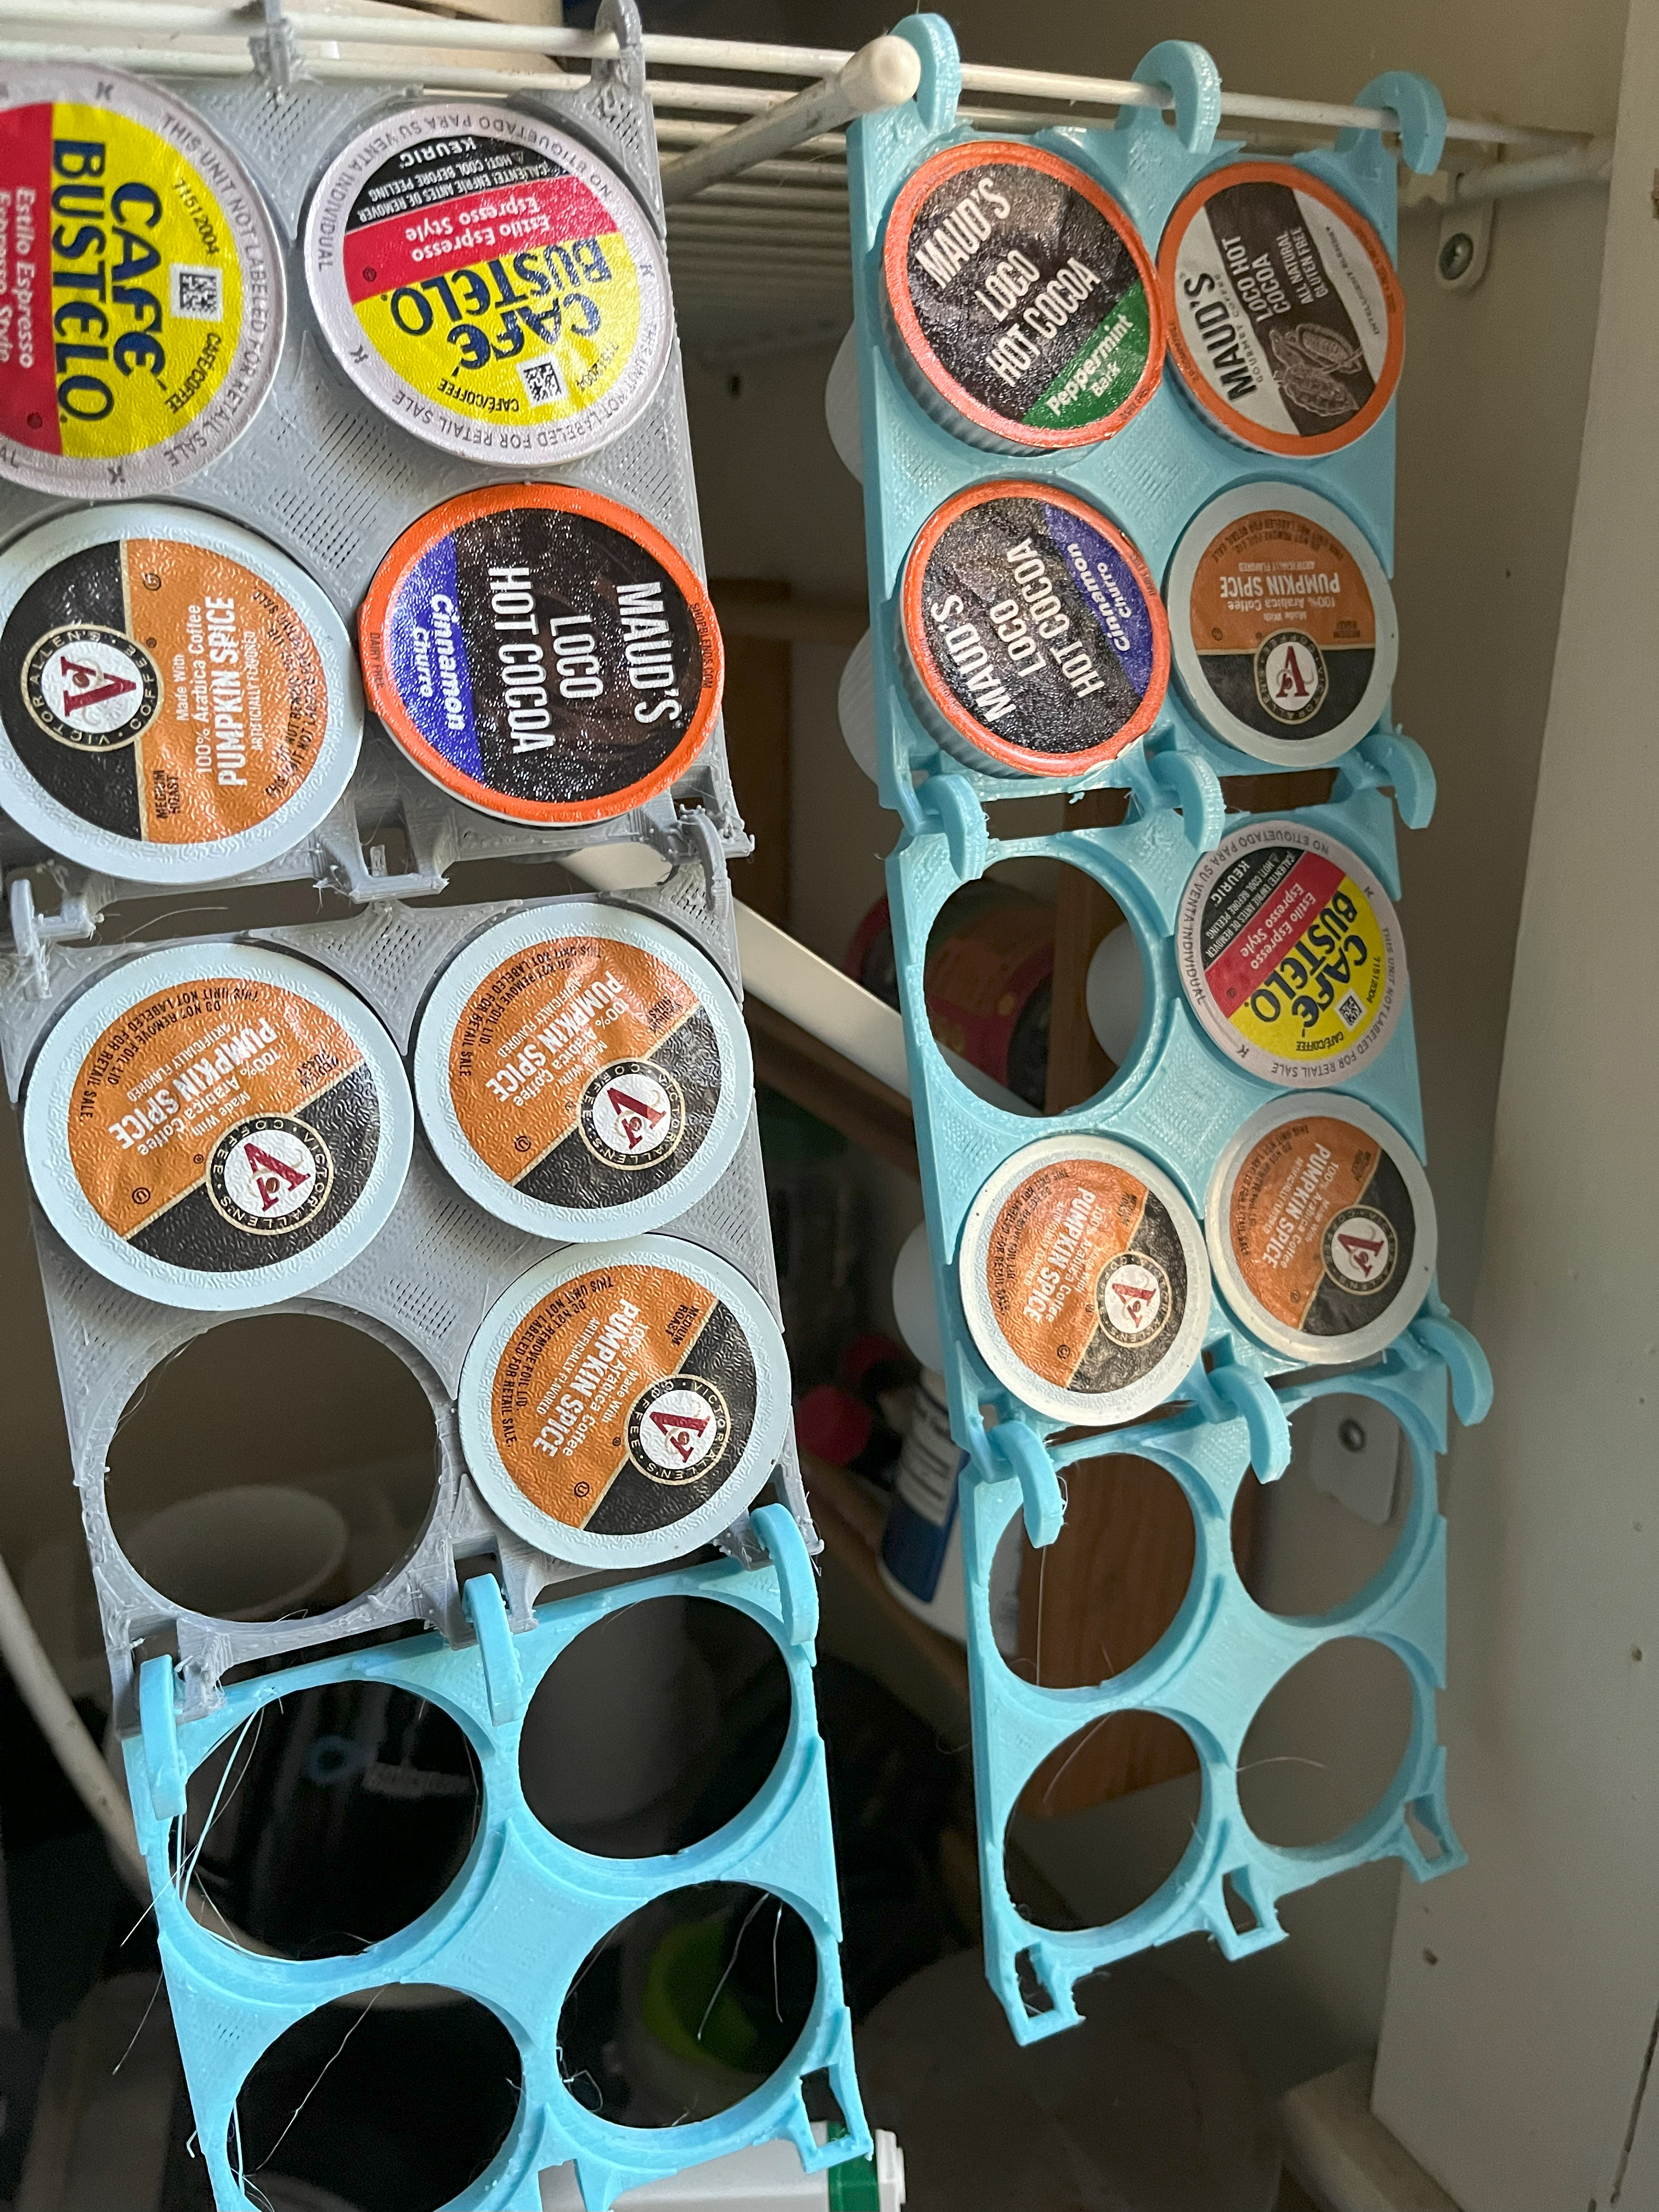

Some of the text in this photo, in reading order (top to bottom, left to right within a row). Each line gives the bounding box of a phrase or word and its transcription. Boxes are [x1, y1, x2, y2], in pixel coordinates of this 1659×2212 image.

[162, 115, 197, 153] THIS
[195, 155, 235, 193] UNIT
[366, 177, 413, 202] PEELING
[414, 165, 456, 189] BEFORE
[229, 198, 256, 238] NOT
[402, 212, 453, 245] Style
[408, 212, 550, 266] Estilo Espresso
[914, 171, 1014, 291] MAUD'S
[10, 187, 36, 368] Estilo Espresso
[244, 242, 268, 334] LABELED
[974, 245, 1041, 324] LOCO
[1219, 233, 1273, 323] LOCO HOT
[1250, 253, 1292, 315] COCOA
[1272, 231, 1315, 305] ALL NATURAL
[1288, 225, 1329, 298] GLUTEN FREE
[986, 255, 1098, 388] HOT COCOA
[1178, 272, 1261, 400] MAUD'S
[1045, 309, 1135, 419] Peppermint
[204, 379, 249, 439] RETAIL
[162, 432, 207, 468] SALE
[1063, 539, 1131, 655] Cinnamon
[1219, 572, 1340, 598] PUMPKIN SPICE
[1227, 599, 1261, 611] Coffee
[185, 604, 204, 654] Coffee
[986, 595, 1046, 679] LOCO
[1001, 537, 1105, 701] HOT COCOA
[427, 592, 475, 730] Cinnamon
[486, 565, 556, 752] HOT COCOA
[548, 614, 605, 699] LOCO
[615, 582, 682, 724] MAUD'S
[928, 590, 1017, 724] MAUD'S
[172, 654, 189, 721] Made With
[205, 595, 248, 787] PUMPKIN SPICE
[194, 727, 212, 773] 100%
[1245, 874, 1262, 893] COOL
[1257, 859, 1274, 878] HOT!
[1182, 831, 1331, 1006] NO ETIQUETADO PARA SU VENTA INDIVIDUAL
[1204, 911, 1231, 939] PEELING
[1205, 927, 1233, 958] REMOVER
[1237, 881, 1305, 959] Espresso Style
[1246, 891, 1317, 970] Estilo Espresso
[537, 968, 624, 1054] PUMPKIN
[1290, 935, 1370, 1038] CAFÉ
[1379, 989, 1393, 1009] NOT
[84, 997, 174, 1086] LABELED FOR RETAIL
[172, 1014, 275, 1104] PUMPKIN
[1337, 1051, 1357, 1068] FOR
[1354, 1012, 1386, 1054] LABELED
[126, 1063, 172, 1103] FLAVORED
[484, 1040, 547, 1103] SPICE
[511, 1067, 554, 1109] Coffee
[1272, 1064, 1301, 1076] SALE
[1303, 1062, 1336, 1075] RETAIL
[109, 1086, 178, 1150] SPICE
[181, 1074, 240, 1124] Arabica
[190, 1089, 250, 1138] Made With
[136, 1115, 185, 1158] Coffee
[210, 1118, 285, 1175] COFFEE
[1284, 1142, 1331, 1219] PUMPKIN
[1045, 1186, 1098, 1268] PUMPKIN
[1260, 1216, 1295, 1269] SPICE
[1279, 1233, 1302, 1270] Coffee
[544, 1298, 566, 1318] NOT
[589, 1276, 614, 1291] THIS
[1019, 1266, 1061, 1325] SPICE
[1044, 1283, 1072, 1325] Coffee
[513, 1313, 547, 1358] LABELED
[524, 1325, 556, 1365] REMOVE
[552, 1308, 573, 1330] NOT
[663, 1303, 690, 1338] ROAST
[669, 1305, 701, 1347] MEDIUM
[504, 1356, 522, 1378] FOR
[516, 1364, 533, 1389] FOIL
[532, 1296, 642, 1459] PUMPKIN SPICE
[586, 1357, 629, 1414] Arabica
[499, 1380, 513, 1415] RETAIL
[534, 1371, 568, 1417] FLAVORED
[600, 1367, 640, 1425] Made With
[561, 1412, 595, 1458] Coffee
[645, 1381, 727, 1480] VICTOR ALLEN'S
